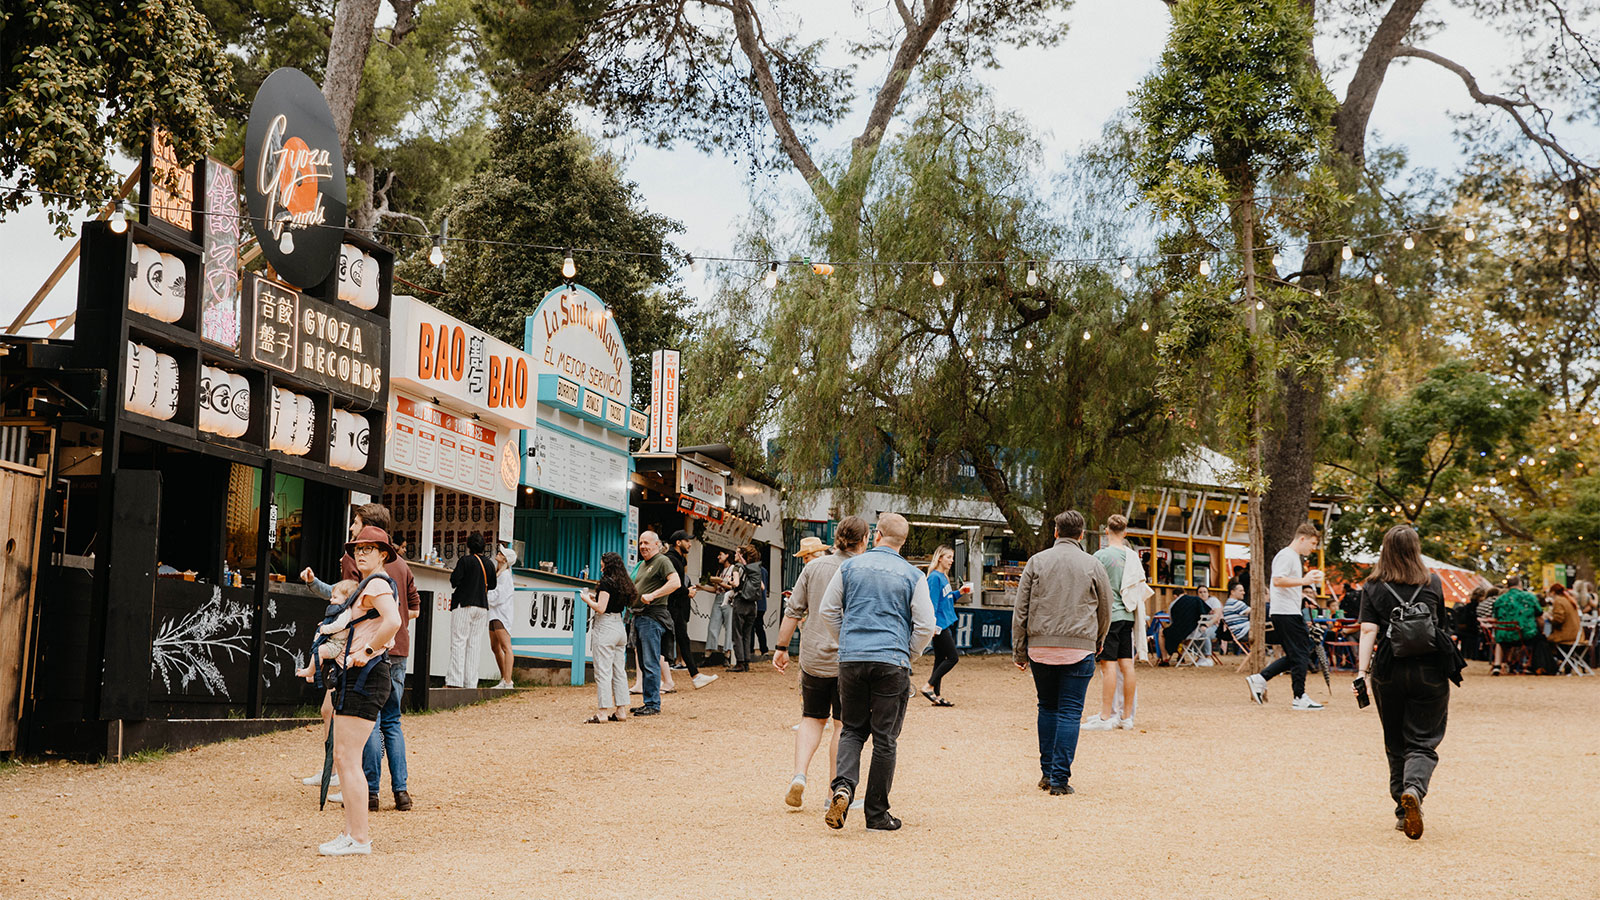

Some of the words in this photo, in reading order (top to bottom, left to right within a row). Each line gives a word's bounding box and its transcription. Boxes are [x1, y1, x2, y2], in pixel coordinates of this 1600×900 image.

[259, 113, 333, 208] Gyoza
[150, 187, 193, 231] GYOZA
[303, 308, 363, 354] GYOZA
[418, 322, 466, 382] BAO
[542, 309, 559, 341] La
[560, 293, 594, 333] Santa
[594, 312, 624, 377] Maria
[303, 342, 382, 393] RECORDS
[488, 355, 528, 409] BAO
[544, 345, 555, 367] EL
[588, 364, 623, 397] SERVICIO
[652, 368, 660, 448] NUGGETS
[665, 367, 675, 448] NUGGETS
[981, 624, 1002, 638] AND
